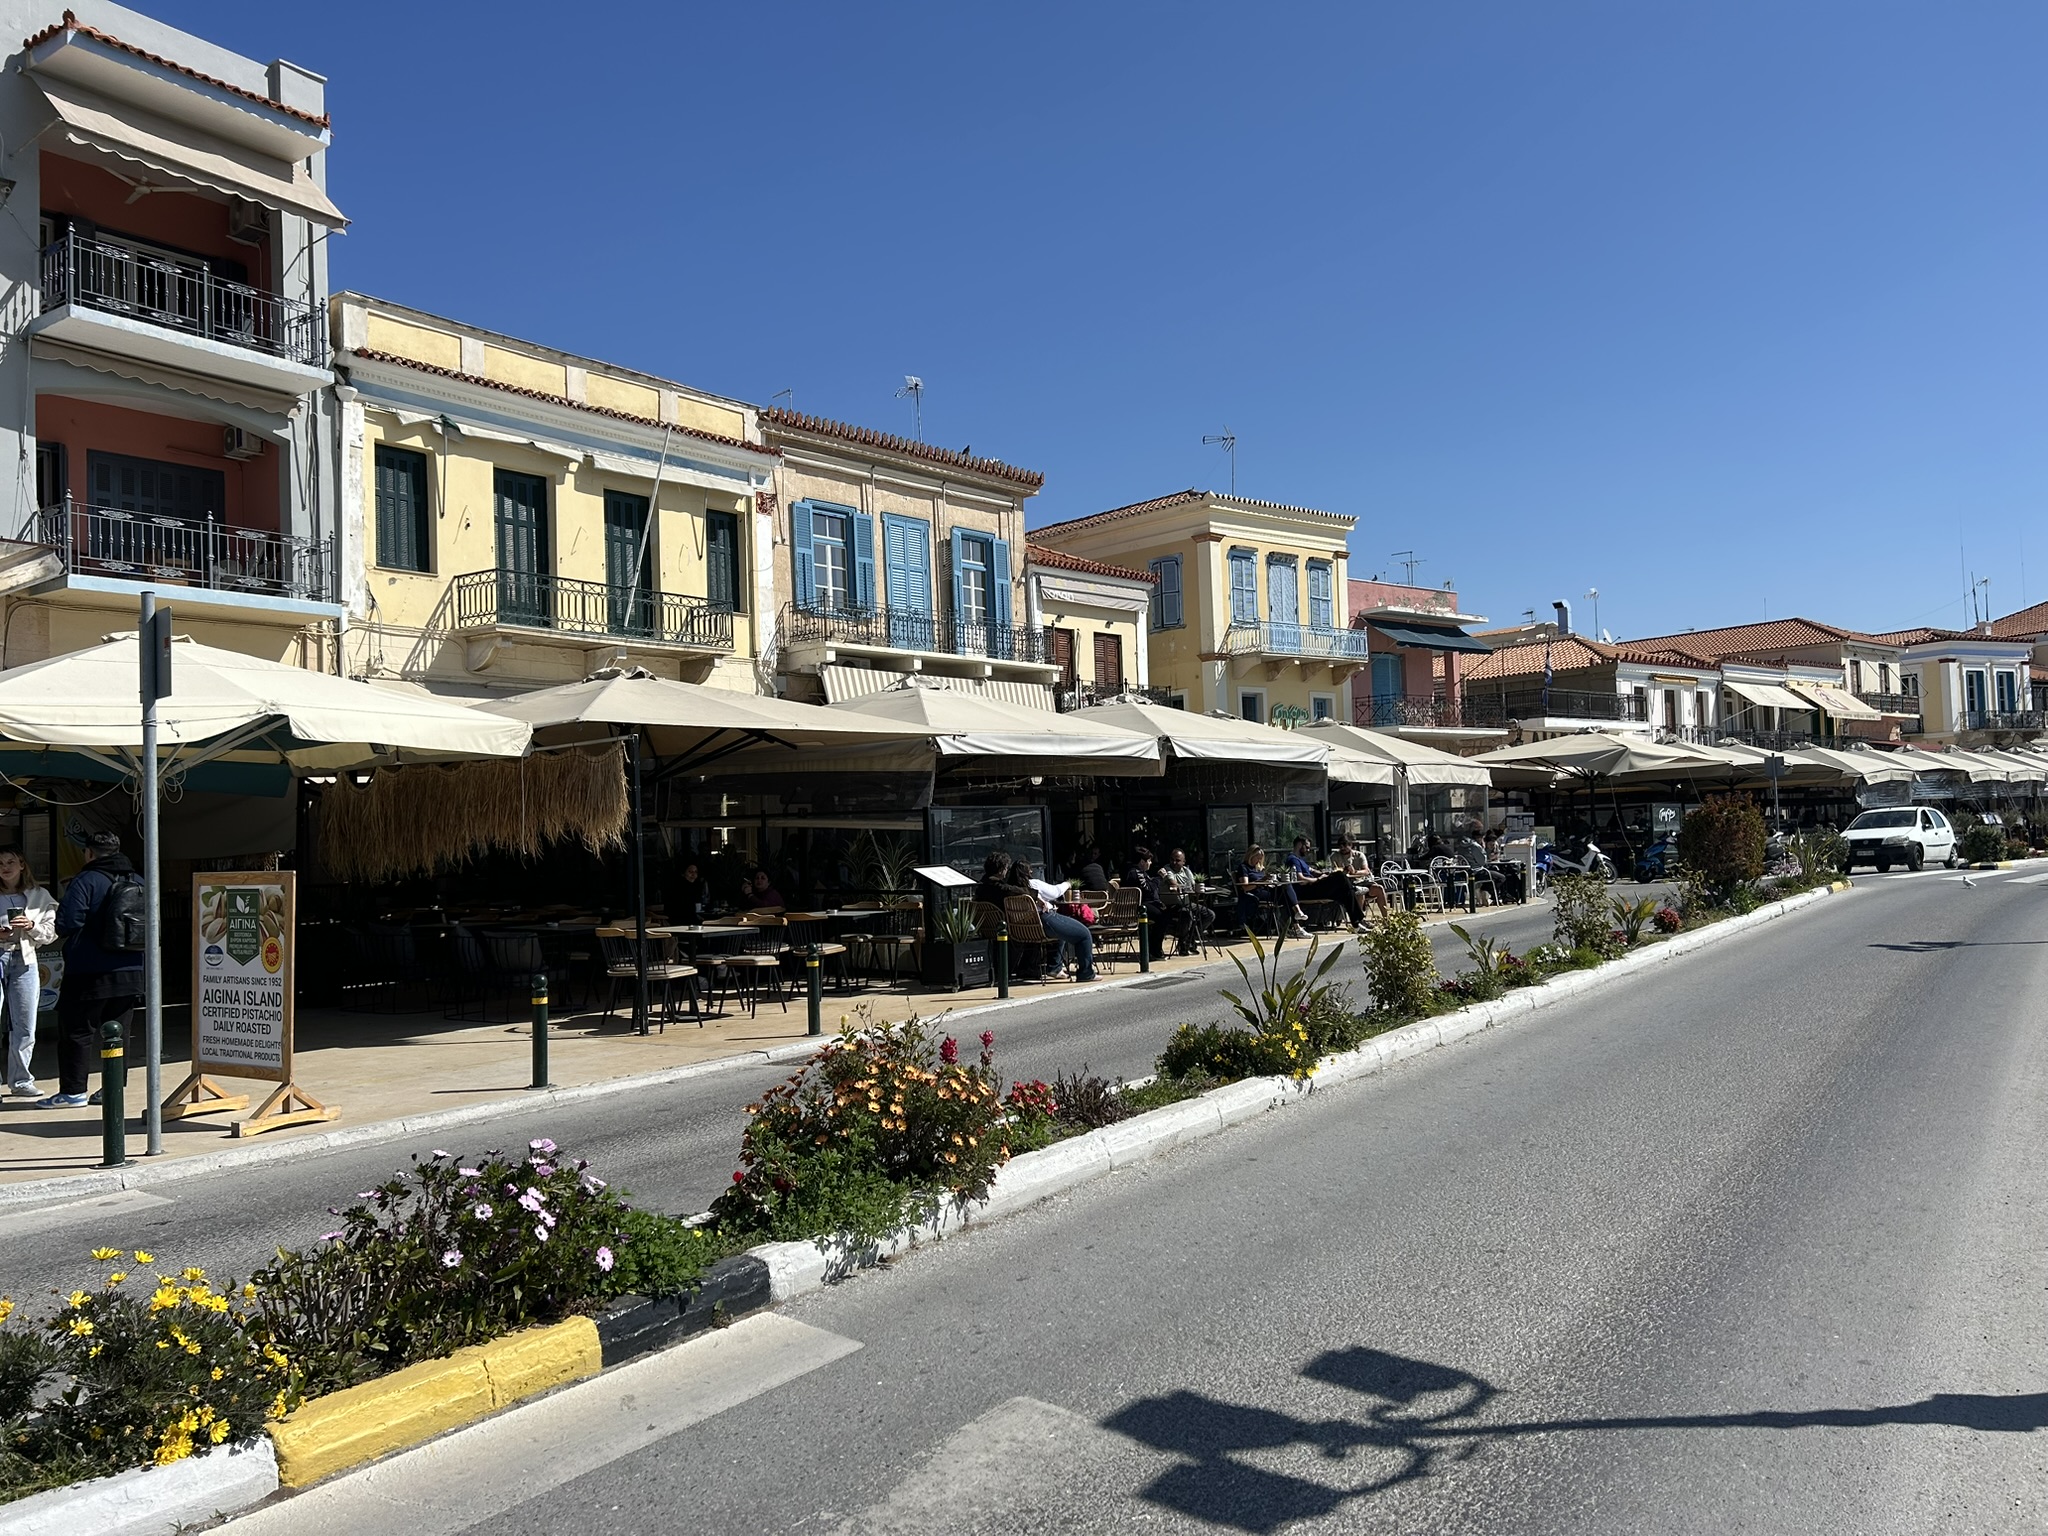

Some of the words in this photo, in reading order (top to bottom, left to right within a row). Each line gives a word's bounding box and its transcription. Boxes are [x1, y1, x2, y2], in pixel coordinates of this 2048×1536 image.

[229, 918, 257, 930] ΑΙΓΙΝΑ
[203, 975, 222, 984] FAMILY
[222, 976, 251, 985] ARTISANS
[251, 977, 267, 986] SINCE
[268, 977, 282, 987] 1952
[203, 988, 241, 1005] AIGINA
[243, 990, 282, 1007] ISLAND
[202, 1006, 240, 1019] CERTIFIED
[242, 1008, 282, 1022] PISTACHIO
[213, 1020, 235, 1032] DAILY
[236, 1022, 272, 1035] ROASTED
[202, 1035, 220, 1045] FRESH
[221, 1037, 254, 1047] HOMEMADE
[254, 1039, 281, 1050] DELIGHTS
[202, 1047, 219, 1057] LOCAL
[219, 1048, 253, 1060] TRADITIONAL
[254, 1051, 281, 1062] PRODUCTS
